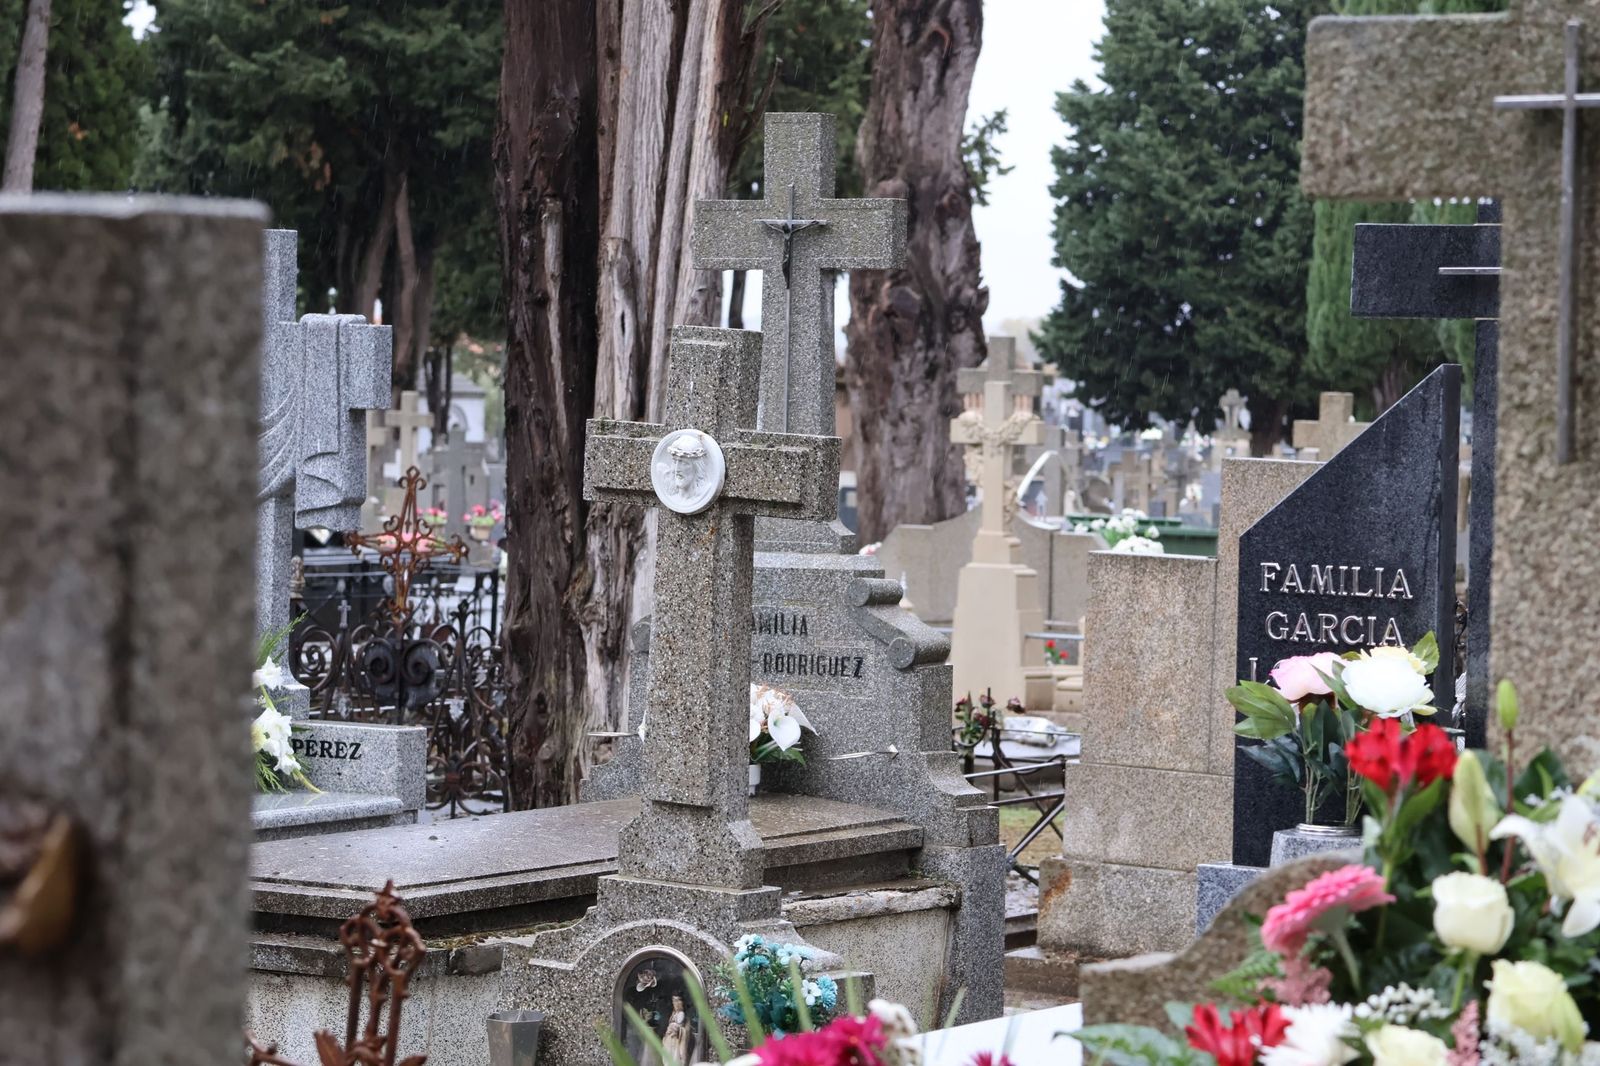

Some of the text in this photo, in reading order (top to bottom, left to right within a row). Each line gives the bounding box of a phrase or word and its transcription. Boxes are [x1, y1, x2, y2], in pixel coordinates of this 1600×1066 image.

[1259, 562, 1413, 600] FAMILIA
[1265, 611, 1406, 648] GARCIA
[291, 734, 362, 760] PÉREZ
